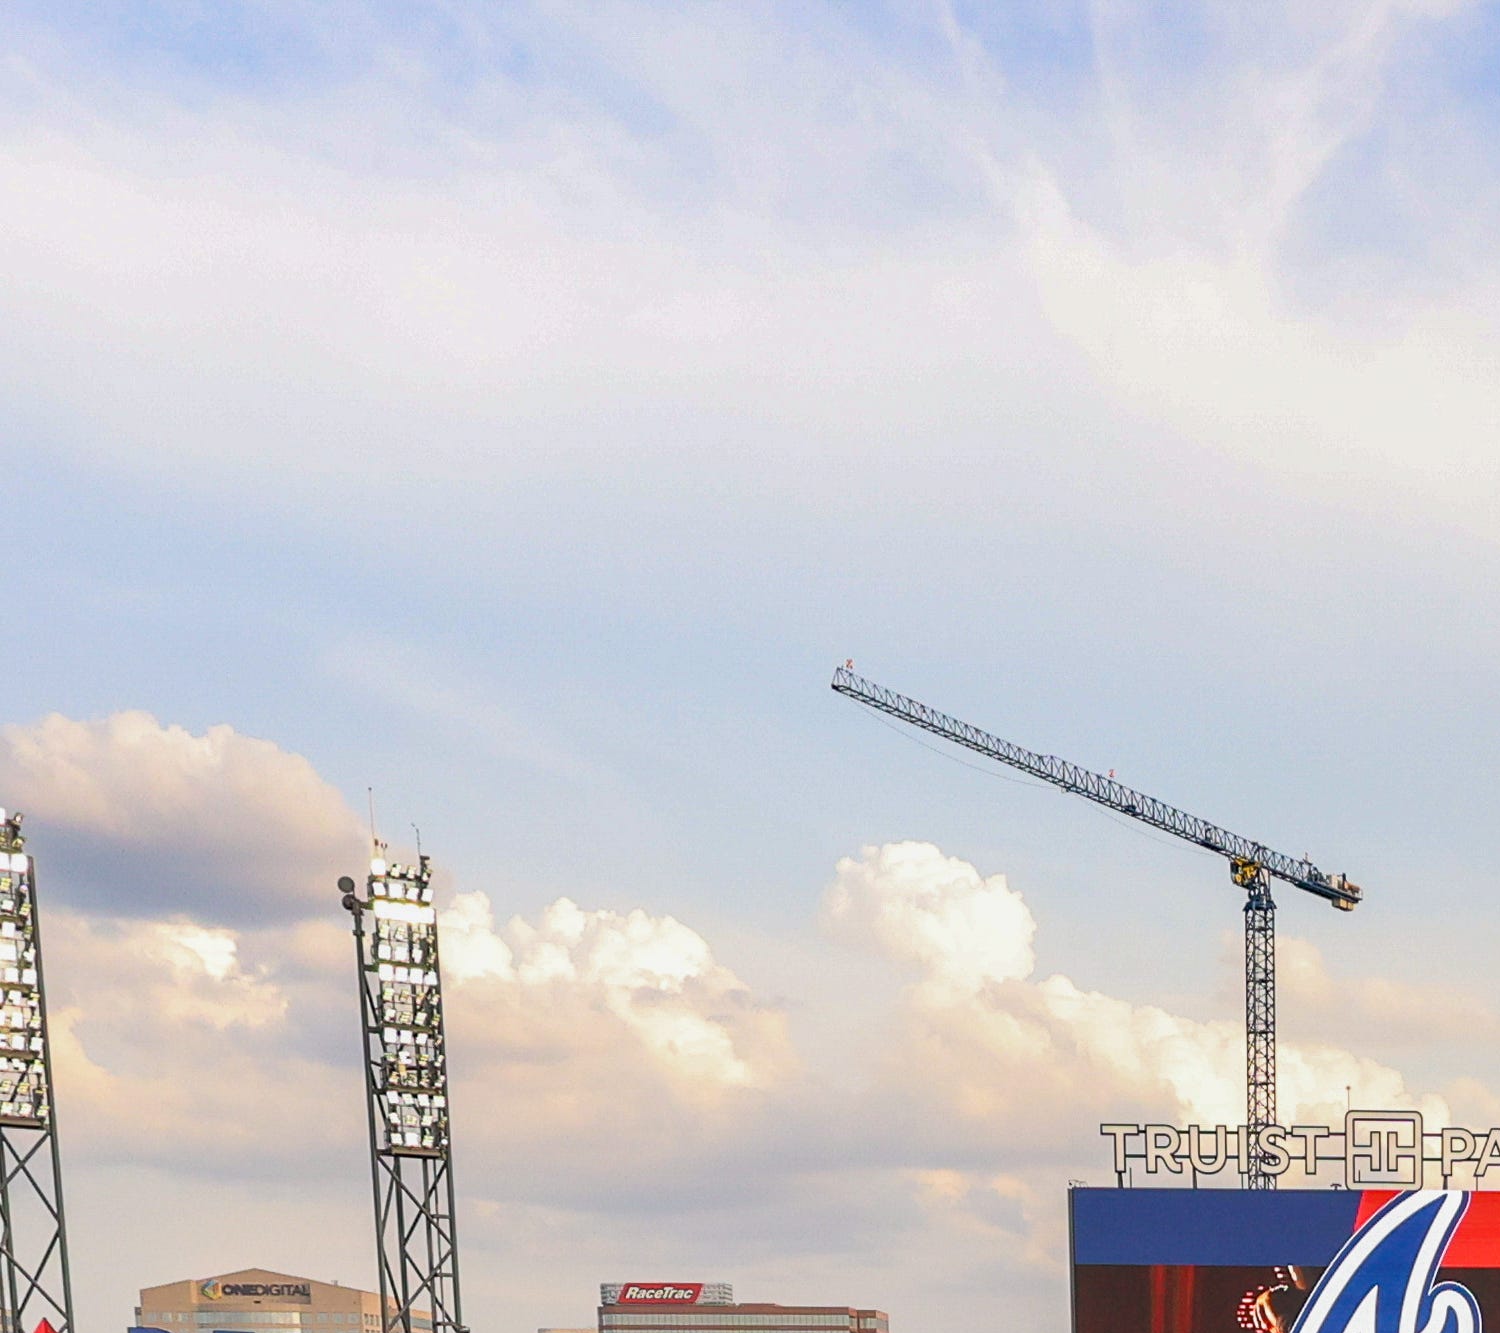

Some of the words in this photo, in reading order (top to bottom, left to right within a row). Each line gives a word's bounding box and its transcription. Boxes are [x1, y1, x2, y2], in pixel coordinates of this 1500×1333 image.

[1100, 1124, 1329, 1176] TRUIST
[221, 1283, 311, 1298] ONEDIGITAL
[624, 1285, 695, 1302] RaceTrac
